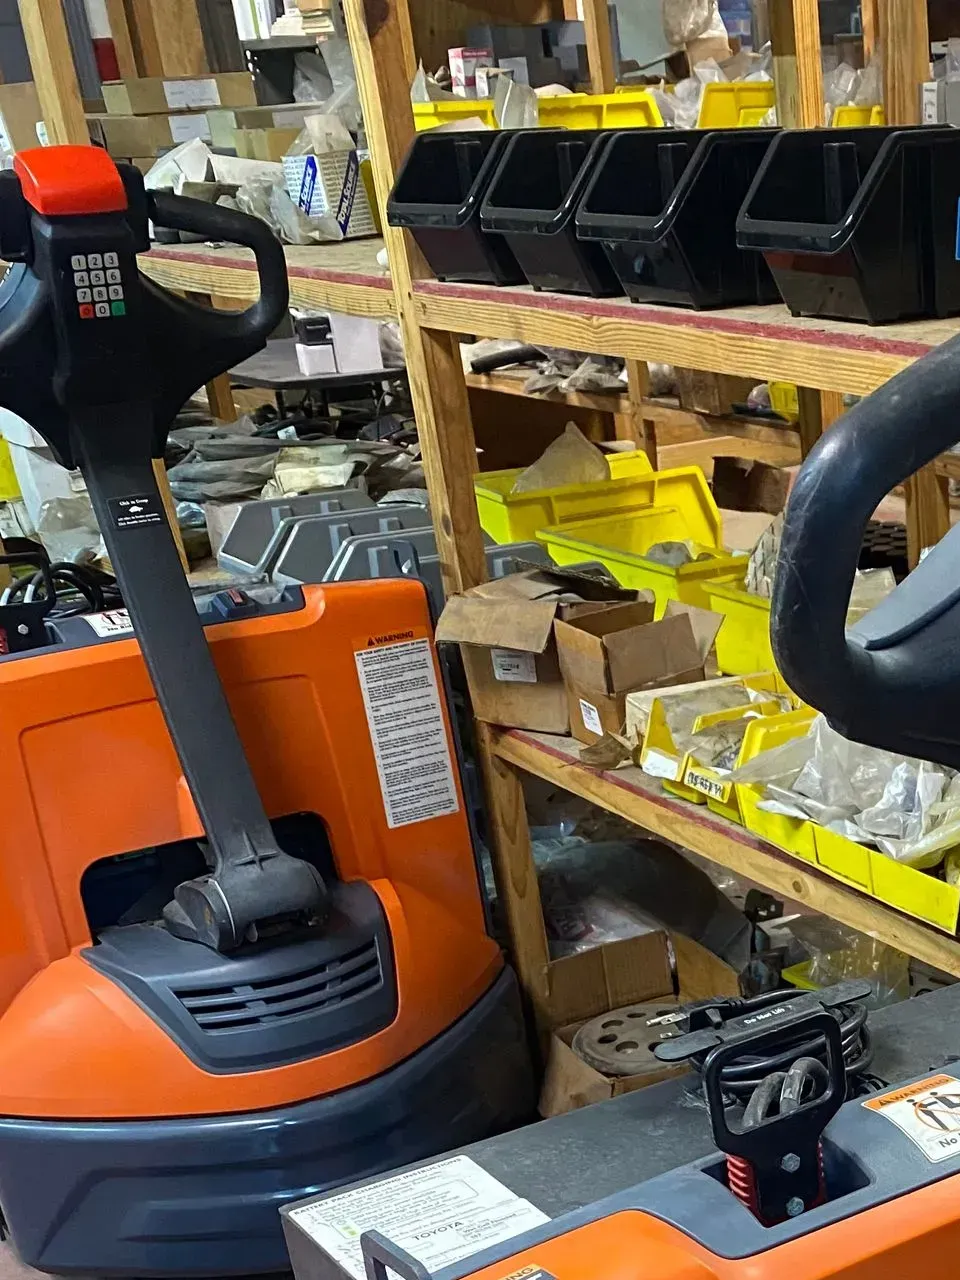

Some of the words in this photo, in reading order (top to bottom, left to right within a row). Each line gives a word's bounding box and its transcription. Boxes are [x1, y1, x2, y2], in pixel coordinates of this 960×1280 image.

[374, 630, 414, 646] WARNING
[939, 1137, 958, 1148] No
[331, 1194, 353, 1202] PACK
[414, 1222, 462, 1240] TOYOTA
